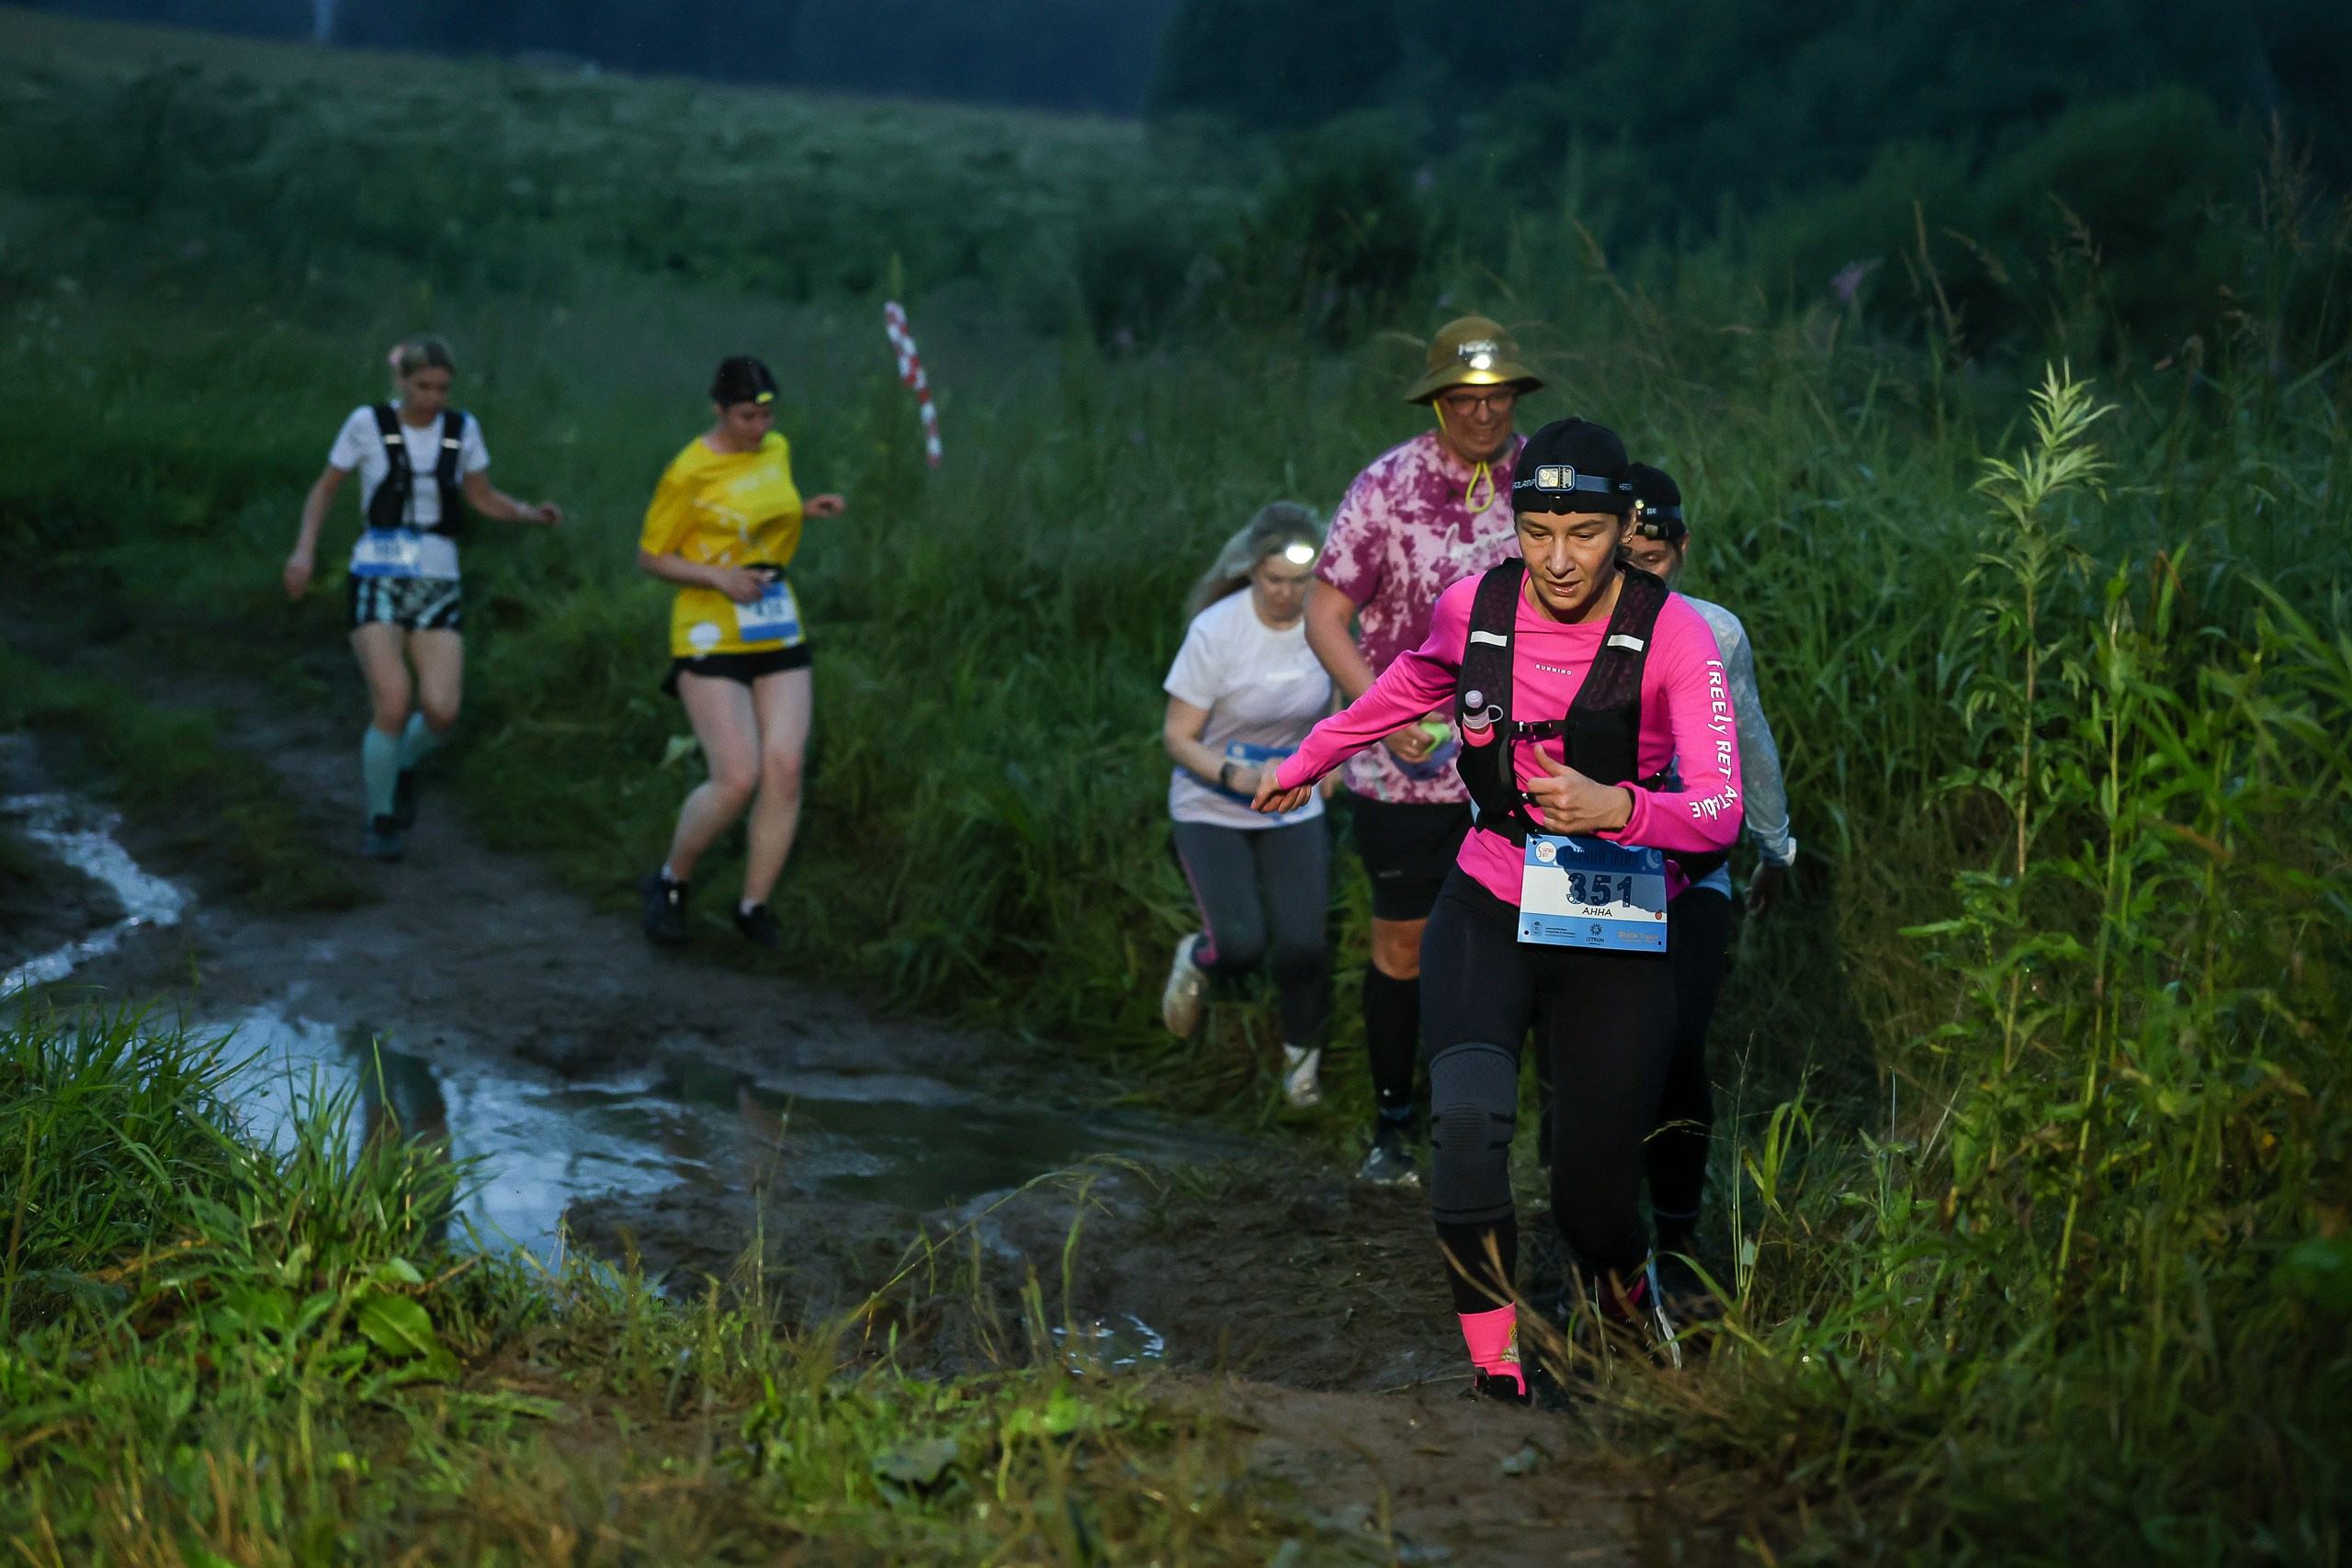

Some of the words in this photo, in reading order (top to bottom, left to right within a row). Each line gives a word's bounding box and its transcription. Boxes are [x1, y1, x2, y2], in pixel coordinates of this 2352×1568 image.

[1535, 663, 1572, 675] RUNNING
[1566, 872, 1633, 908] 351
[1581, 907, 1612, 918] АННА
